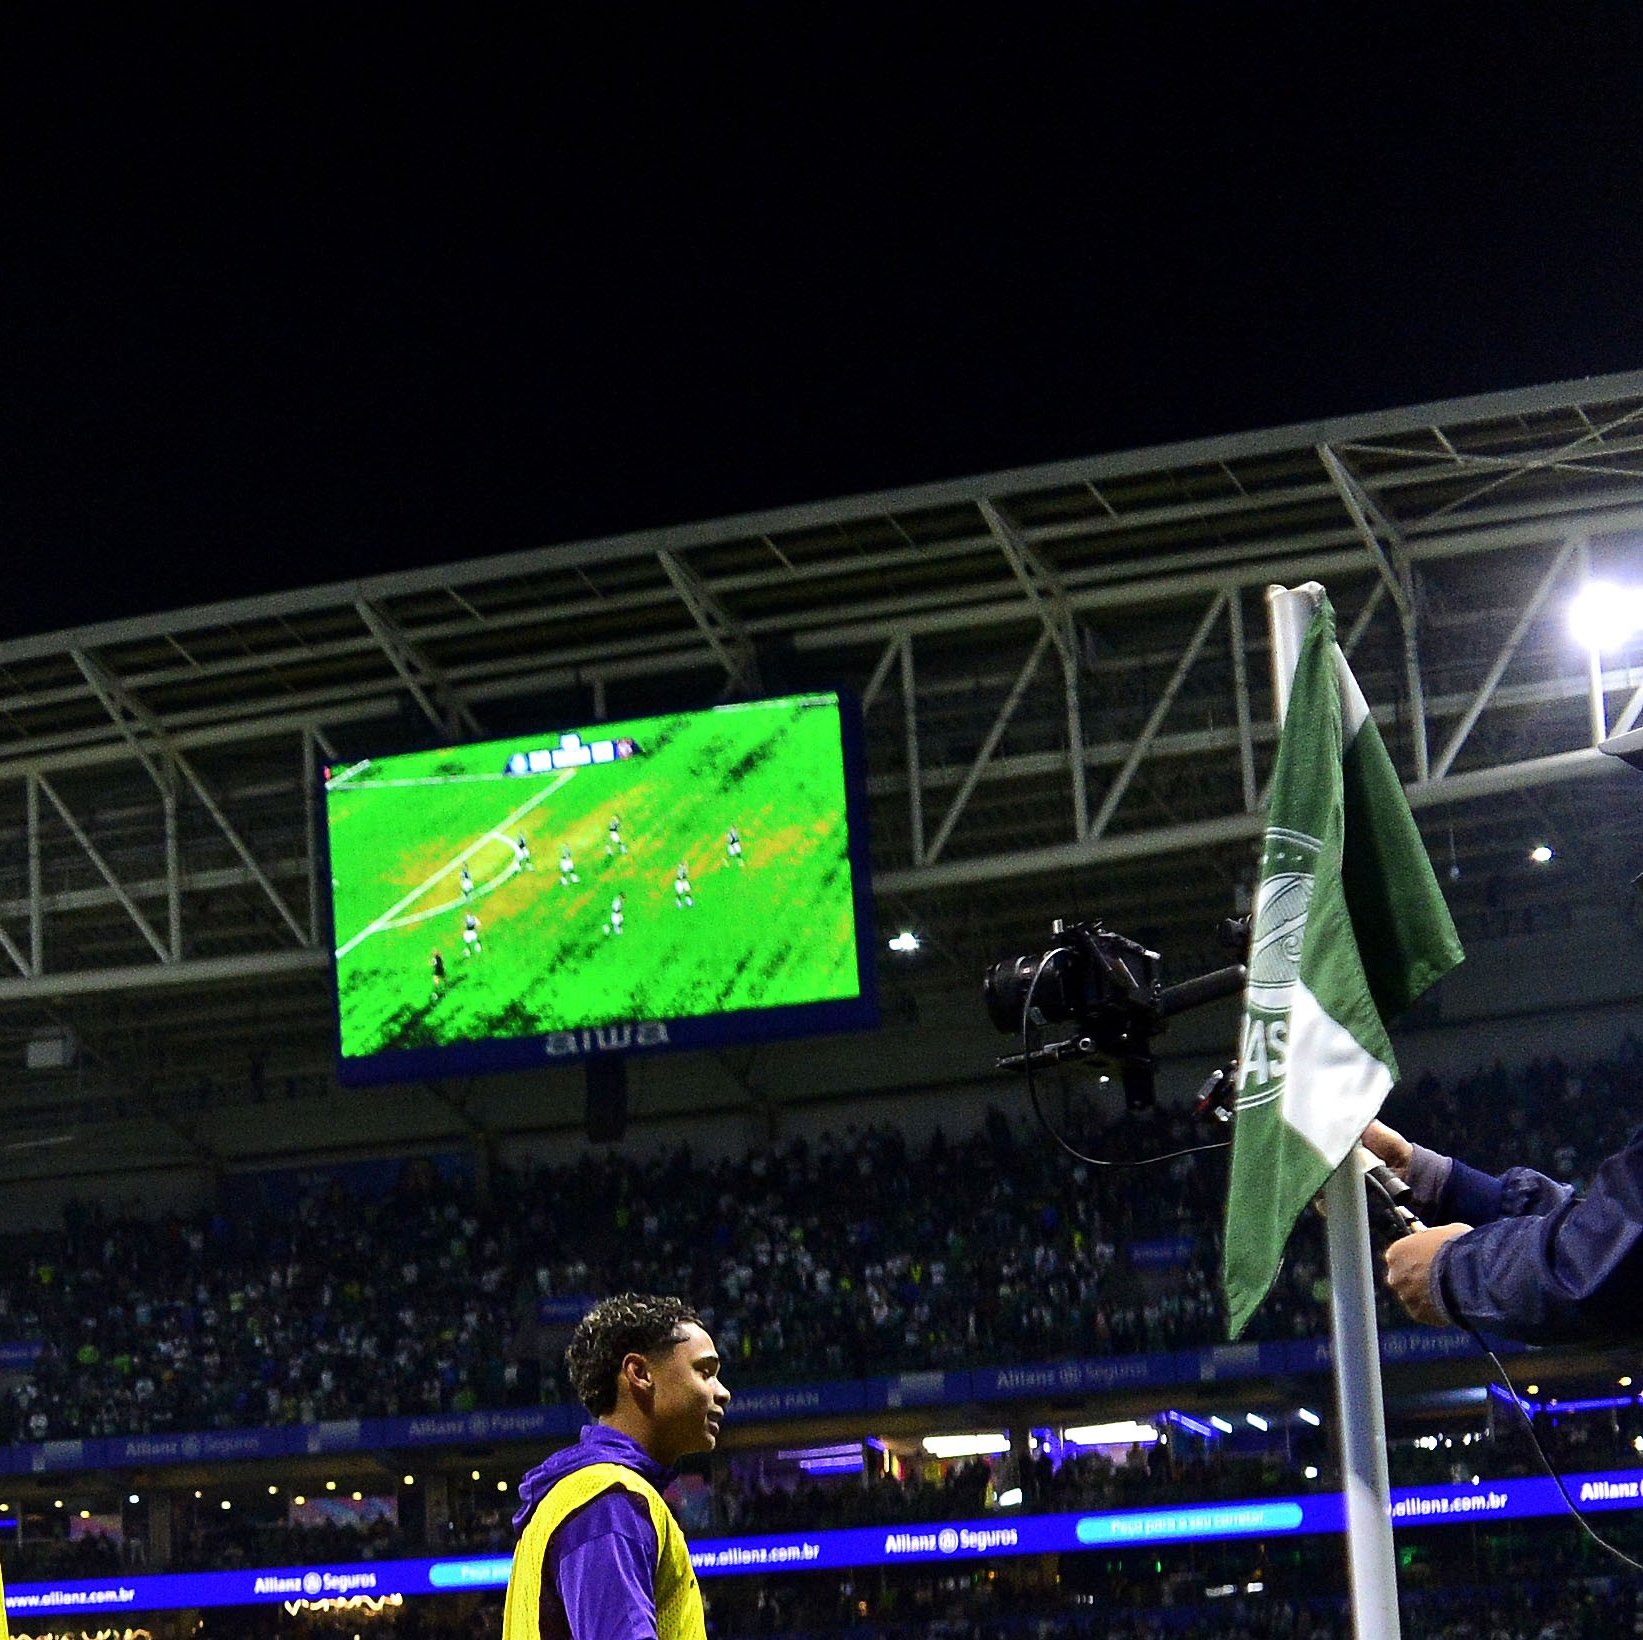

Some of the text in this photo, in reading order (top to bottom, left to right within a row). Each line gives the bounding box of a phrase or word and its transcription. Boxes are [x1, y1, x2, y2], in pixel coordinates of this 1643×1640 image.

[1580, 1480, 1639, 1501] Allianz
[1389, 1491, 1508, 1518] .allianz.com.br
[886, 1528, 1017, 1554] Allianz Seguros
[254, 1572, 376, 1594] Allianz Seguros
[5, 1587, 135, 1608] www.allianz.com.br
